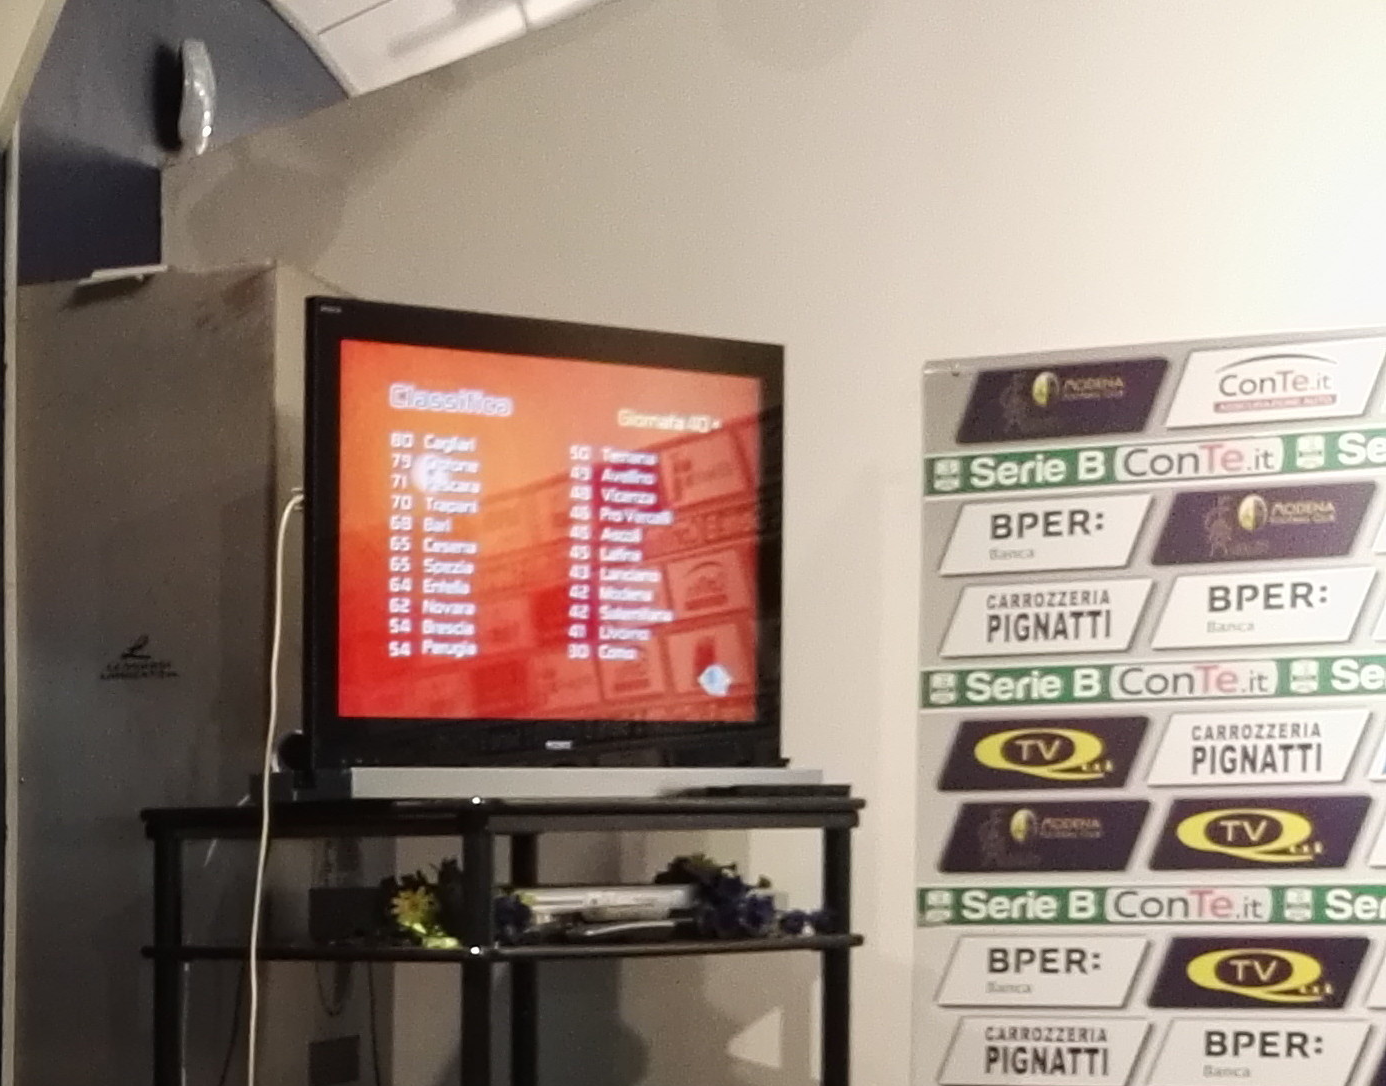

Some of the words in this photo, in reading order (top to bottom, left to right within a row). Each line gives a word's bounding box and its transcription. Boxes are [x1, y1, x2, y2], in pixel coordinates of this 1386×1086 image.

[1219, 370, 1332, 397] ConTe.it
[970, 455, 1066, 486] Serie
[1078, 451, 1105, 480] B
[1126, 444, 1276, 477] ConTe.it
[990, 509, 1104, 541] BPER:
[986, 591, 1110, 608] CARROZZERIA
[1208, 581, 1328, 612] BPER:
[987, 611, 1111, 643] PIGNATTI
[1192, 722, 1321, 741] CARROZZERIA
[1014, 739, 1061, 761] TV
[1192, 744, 1322, 775] PIGNATTI
[1220, 820, 1269, 841] TV
[961, 889, 1056, 920] Serie
[1068, 890, 1096, 918] B
[1113, 889, 1262, 920] ConTe.it
[988, 948, 1101, 974] BPER:
[1229, 959, 1276, 982] TV
[985, 1027, 1108, 1043] CARROZZERIA
[984, 1047, 1108, 1076] PIGNATTI
